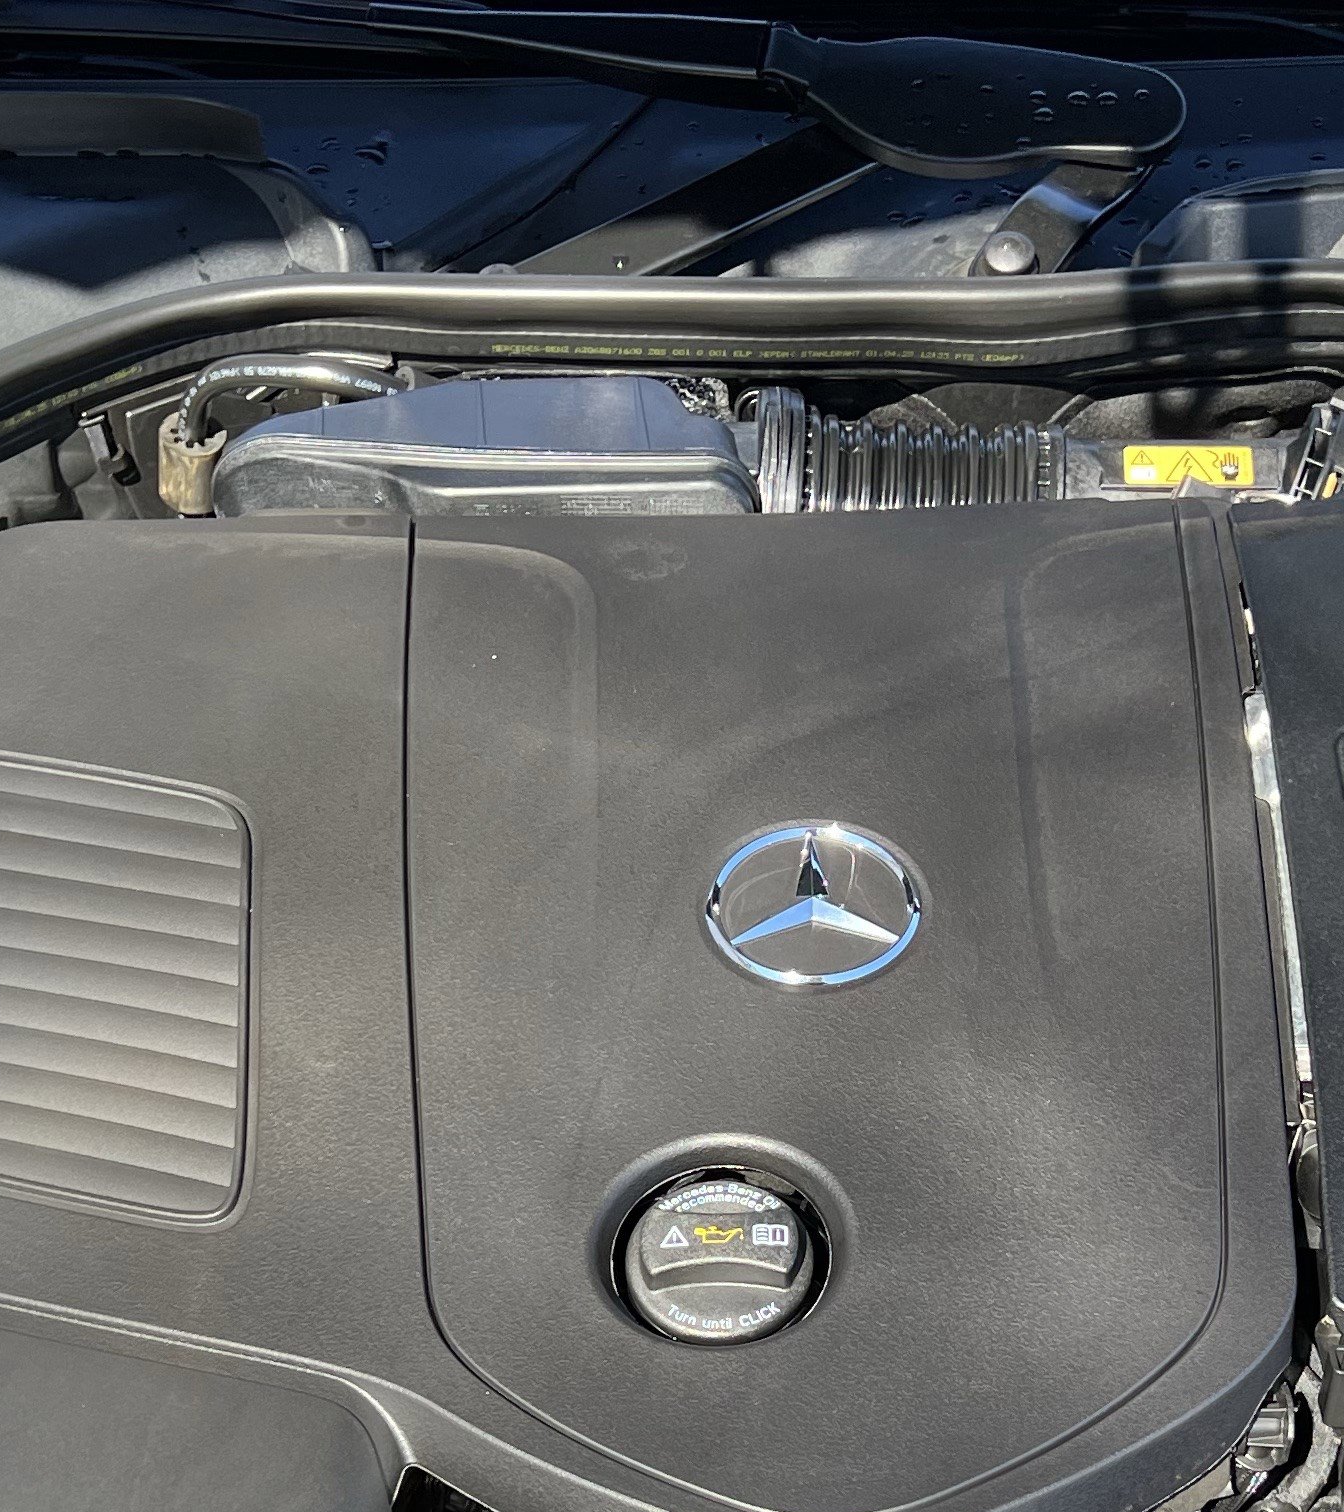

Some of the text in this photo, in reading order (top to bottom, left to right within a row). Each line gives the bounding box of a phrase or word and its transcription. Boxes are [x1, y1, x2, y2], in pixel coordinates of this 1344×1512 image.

[658, 1183, 781, 1212] Mercedes-Benz Oil
[676, 1193, 766, 1213] recommended
[667, 1301, 781, 1329] Turn until CLICK
